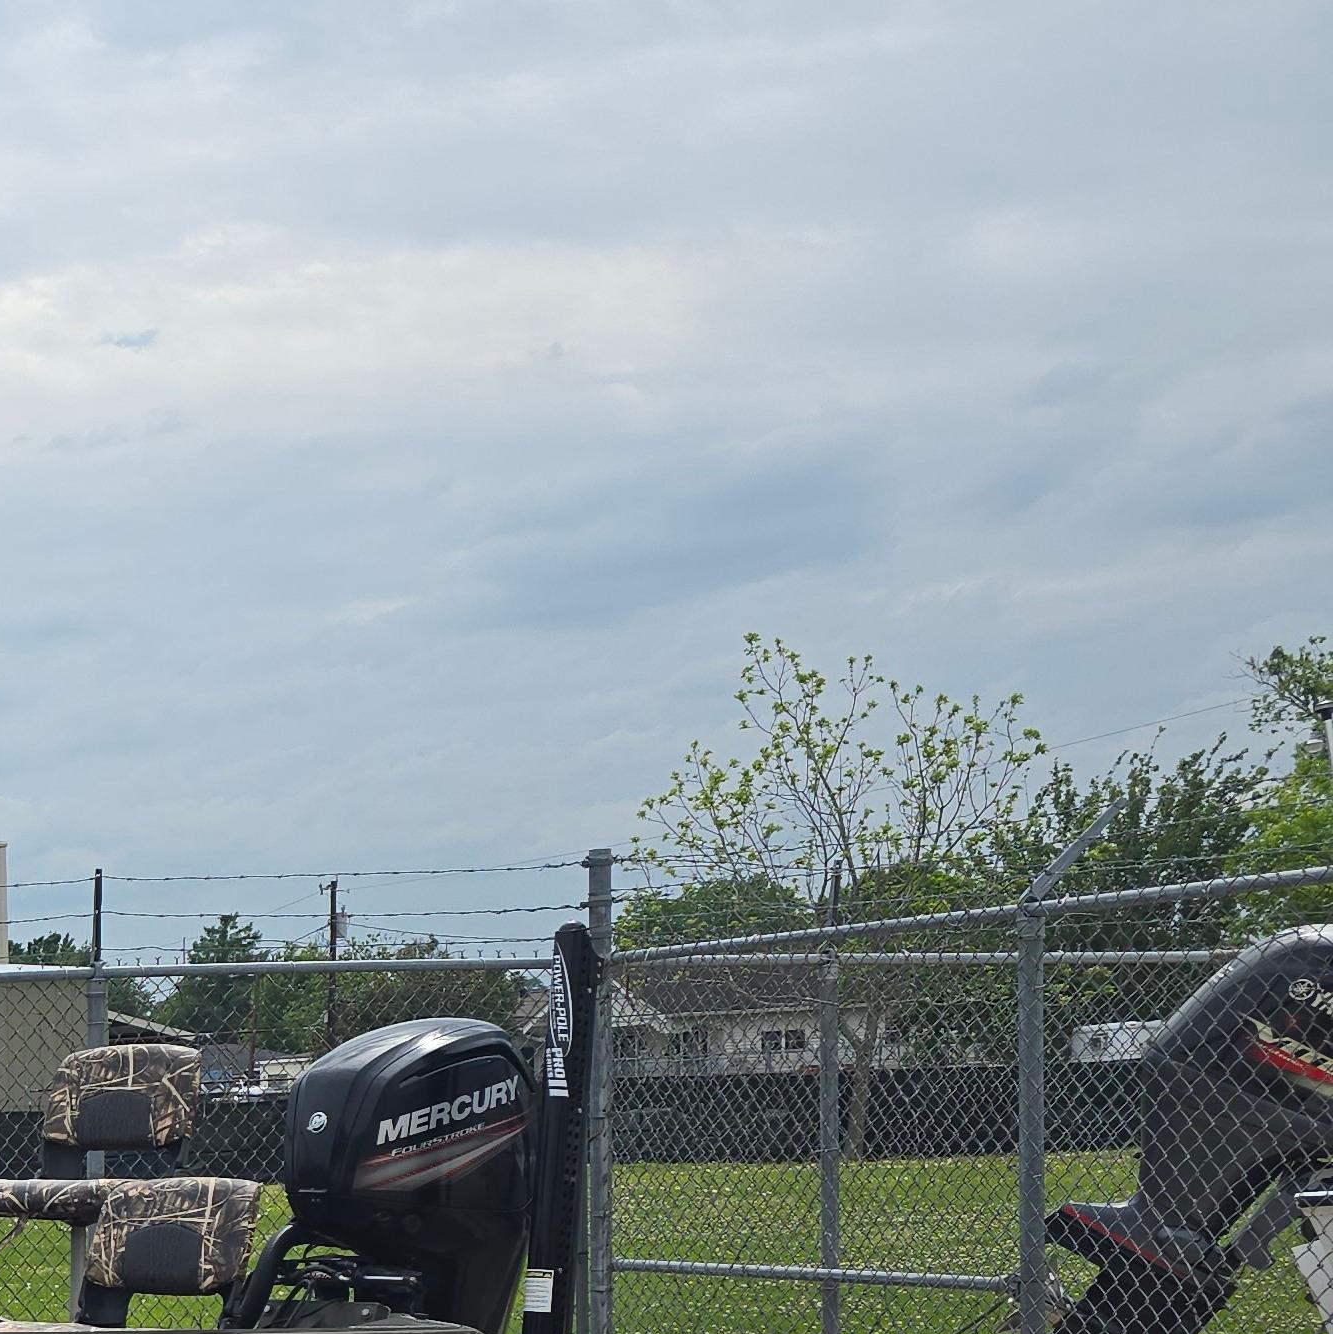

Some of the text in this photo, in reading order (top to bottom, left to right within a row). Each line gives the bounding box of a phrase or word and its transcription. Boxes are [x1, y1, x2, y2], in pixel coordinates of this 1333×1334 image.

[553, 954, 569, 1043] POWER-POLE
[552, 1047, 566, 1079] PRO
[376, 1074, 519, 1146] MERCURY
[391, 1121, 486, 1157] FOURSTROKE
